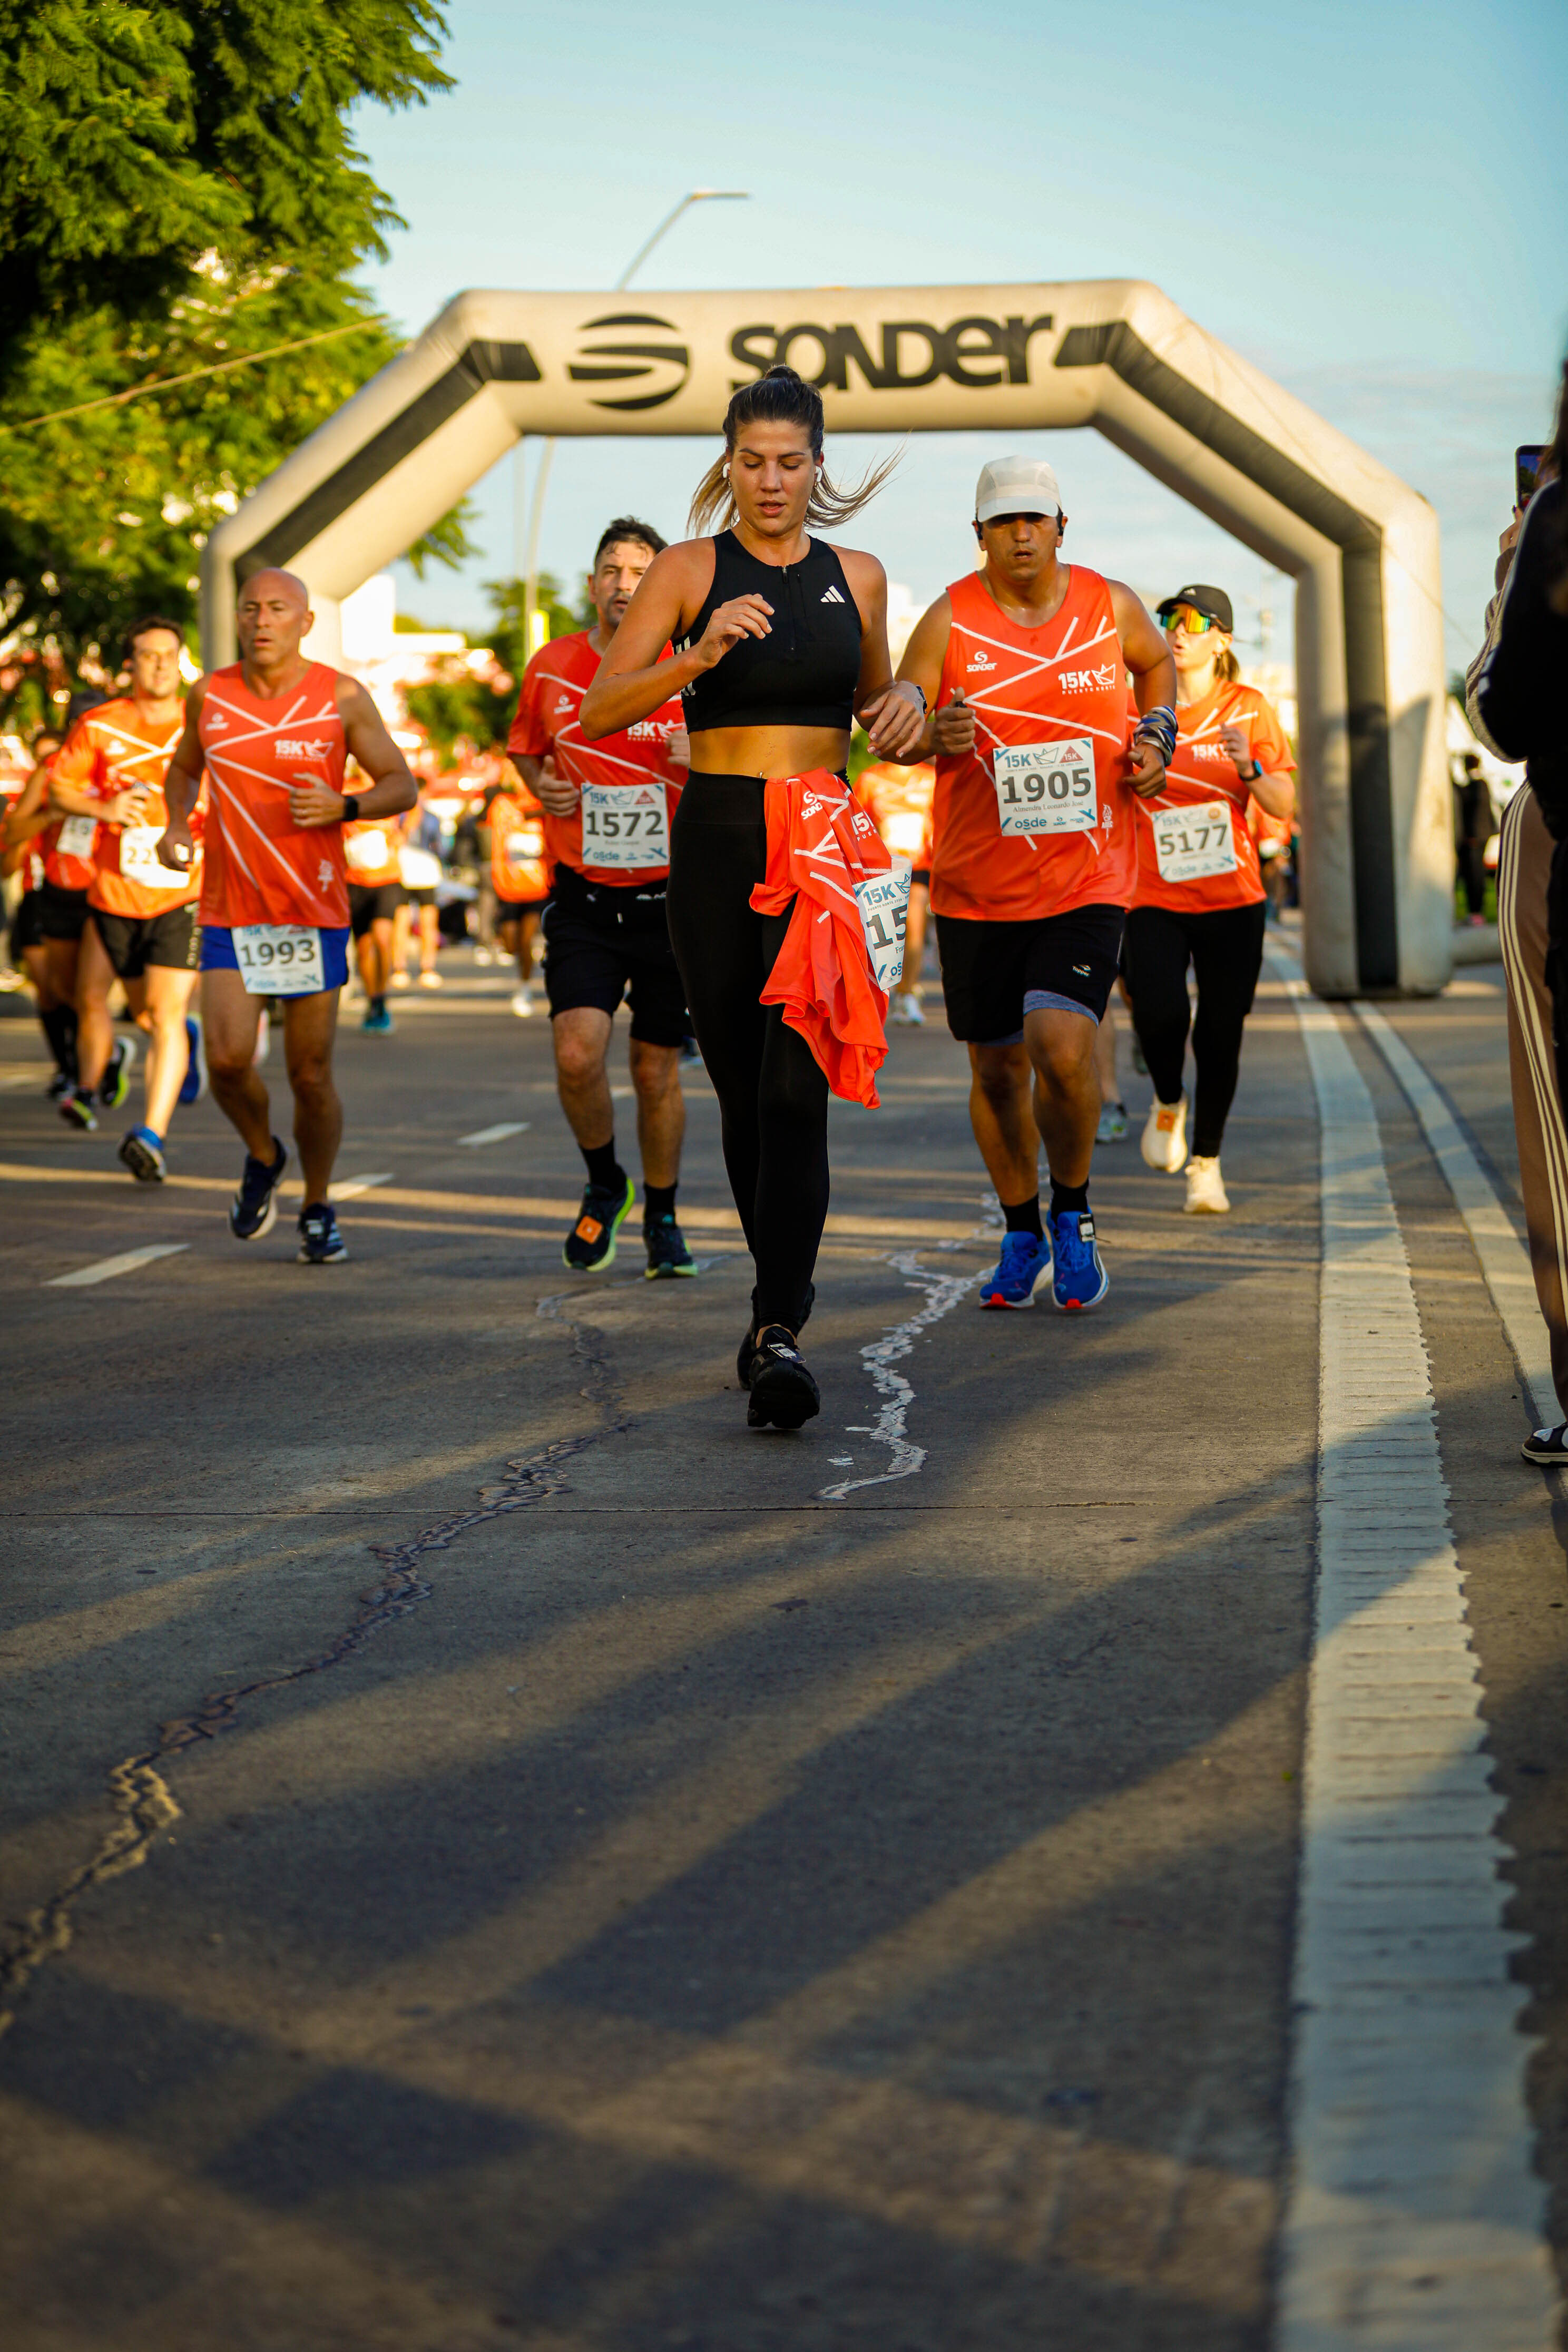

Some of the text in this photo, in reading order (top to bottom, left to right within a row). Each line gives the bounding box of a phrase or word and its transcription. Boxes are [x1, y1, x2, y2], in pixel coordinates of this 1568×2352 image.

[1058, 670, 1093, 689] 15K
[628, 721, 656, 737] 15K
[274, 739, 304, 754] 15K
[1191, 744, 1219, 757] 15K
[1005, 753, 1032, 768] 15K
[1002, 767, 1092, 804] 1905
[589, 791, 609, 805] 15K
[1013, 805, 1042, 813] Almendra
[1043, 801, 1071, 810] Leonardo
[586, 810, 664, 838] 1572
[1015, 817, 1047, 830] osde
[1159, 822, 1228, 856] 5177
[863, 883, 897, 905] 15K
[240, 938, 316, 966] 1993
